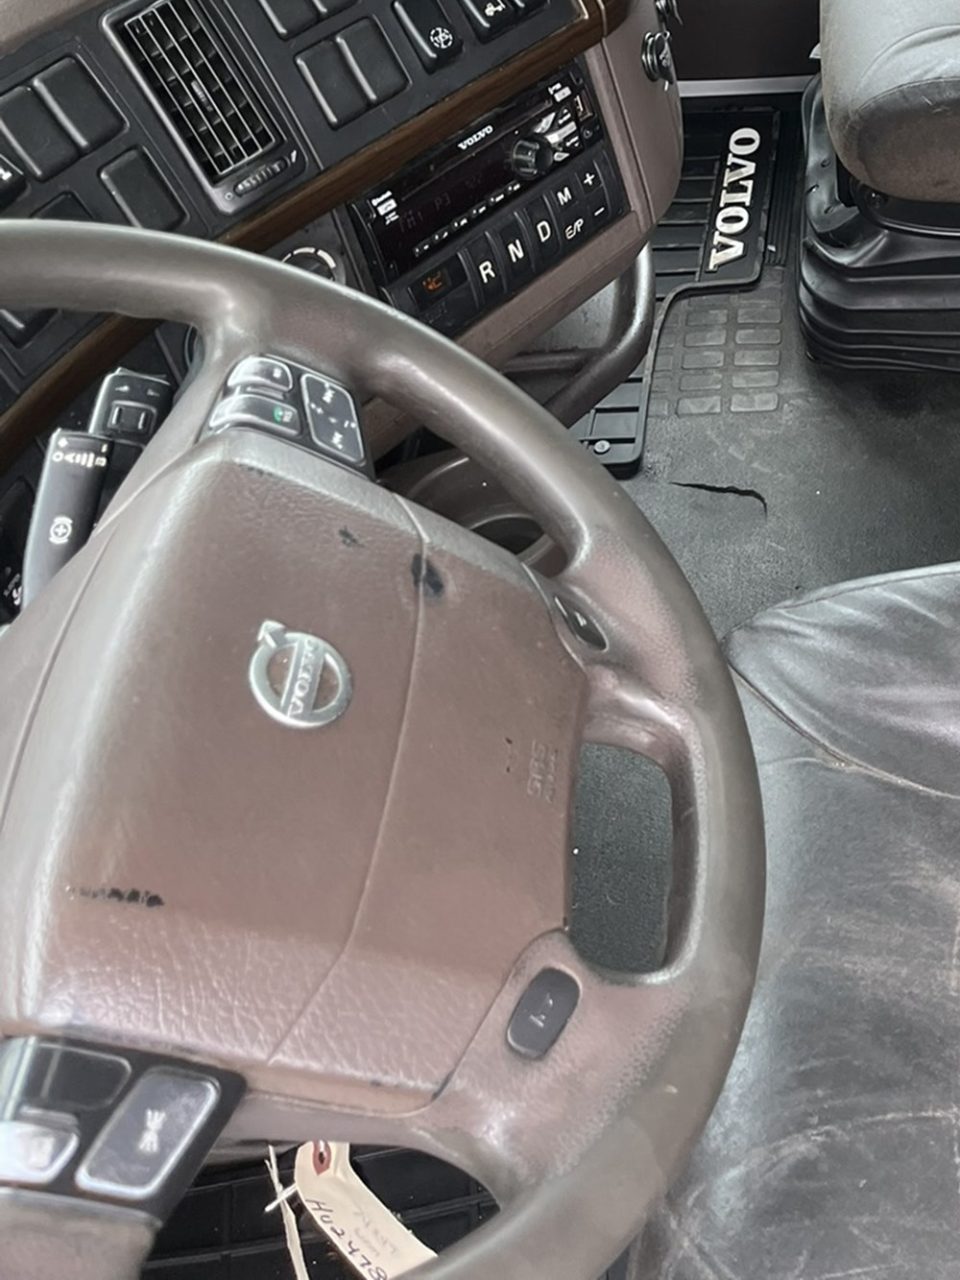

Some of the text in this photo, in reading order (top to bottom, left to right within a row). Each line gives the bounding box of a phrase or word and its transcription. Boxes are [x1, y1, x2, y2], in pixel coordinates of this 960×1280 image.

[457, 124, 494, 150] VOLVO
[557, 186, 572, 206] M
[708, 127, 761, 271] VOLVO
[565, 218, 584, 240] E/P
[479, 220, 552, 283] R N D
